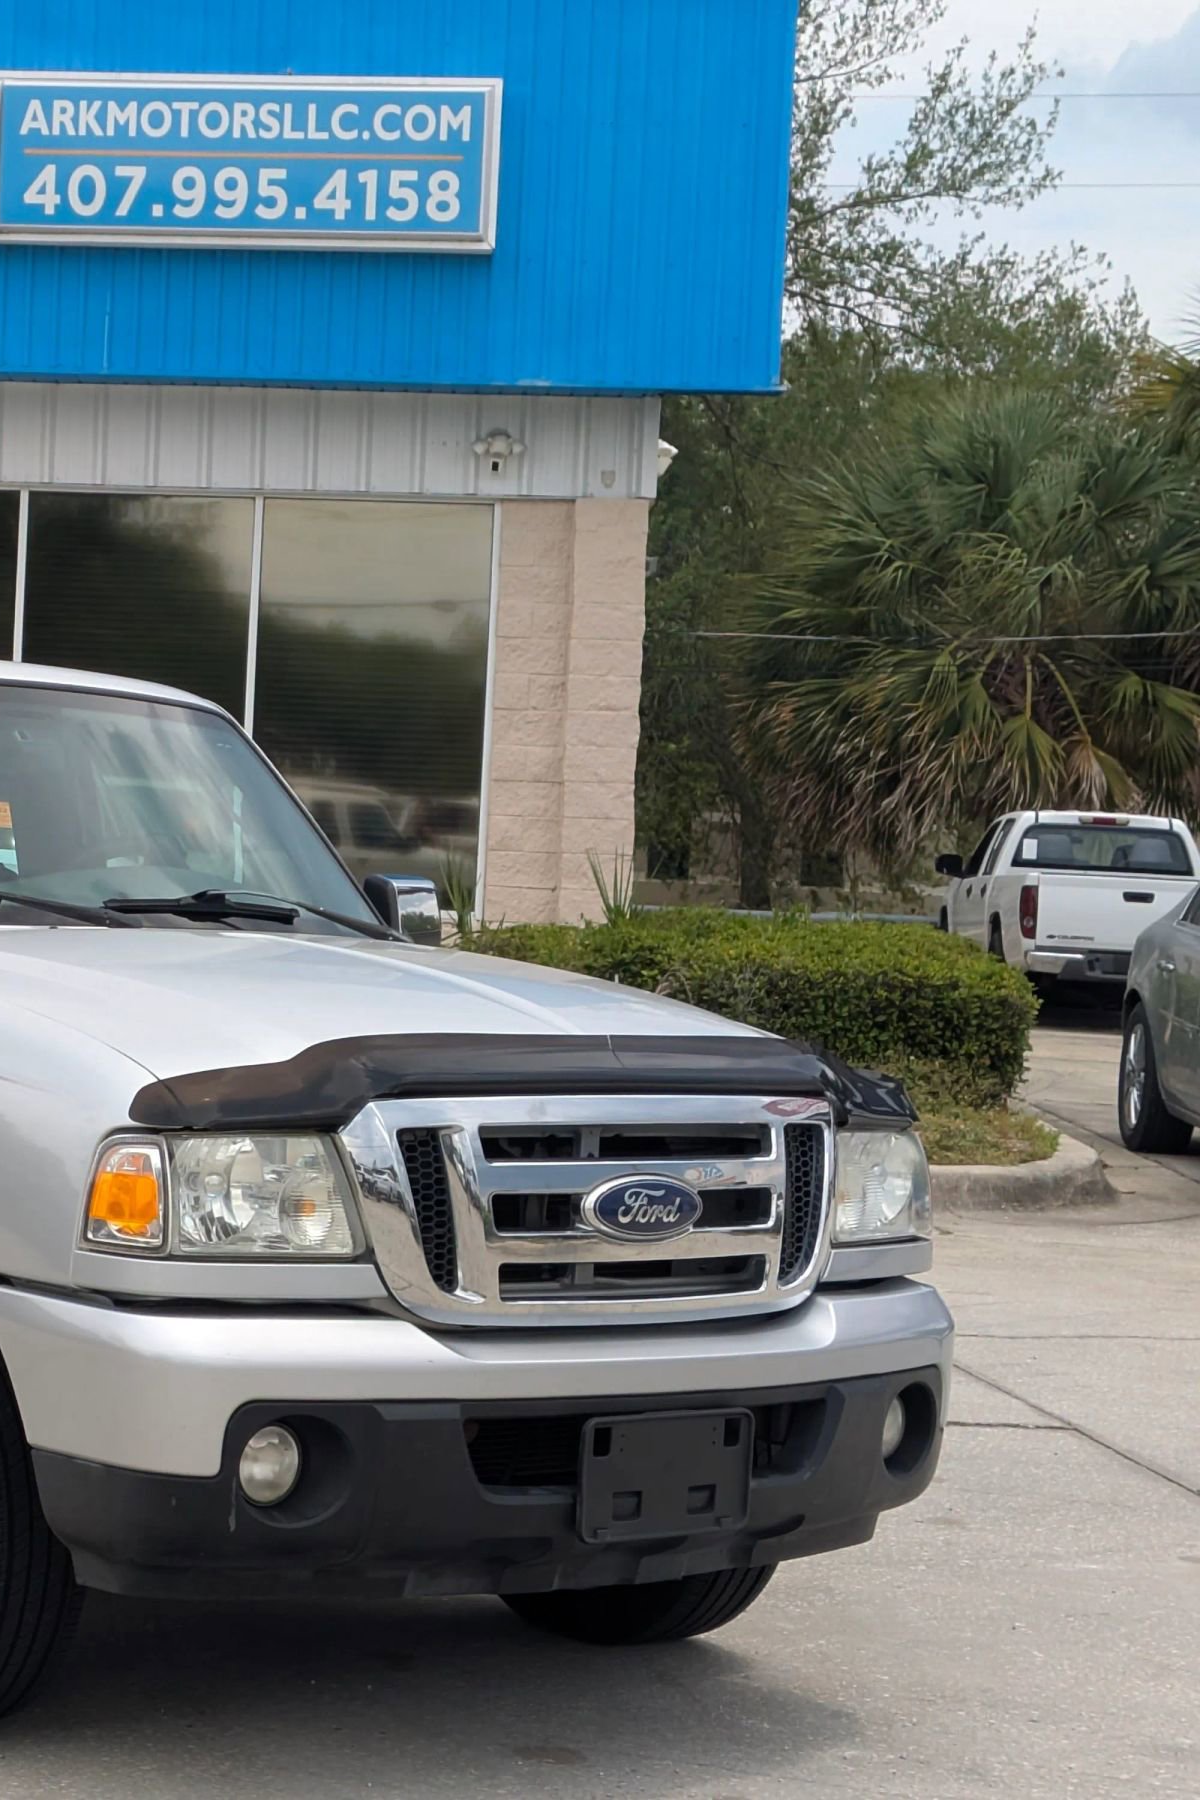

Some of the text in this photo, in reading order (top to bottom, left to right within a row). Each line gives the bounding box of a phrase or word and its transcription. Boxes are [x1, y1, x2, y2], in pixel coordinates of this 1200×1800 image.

[19, 99, 472, 142] ARKMOTORSLLC.COM
[23, 164, 461, 223] 407.995.4158
[617, 1187, 681, 1225] Ford
